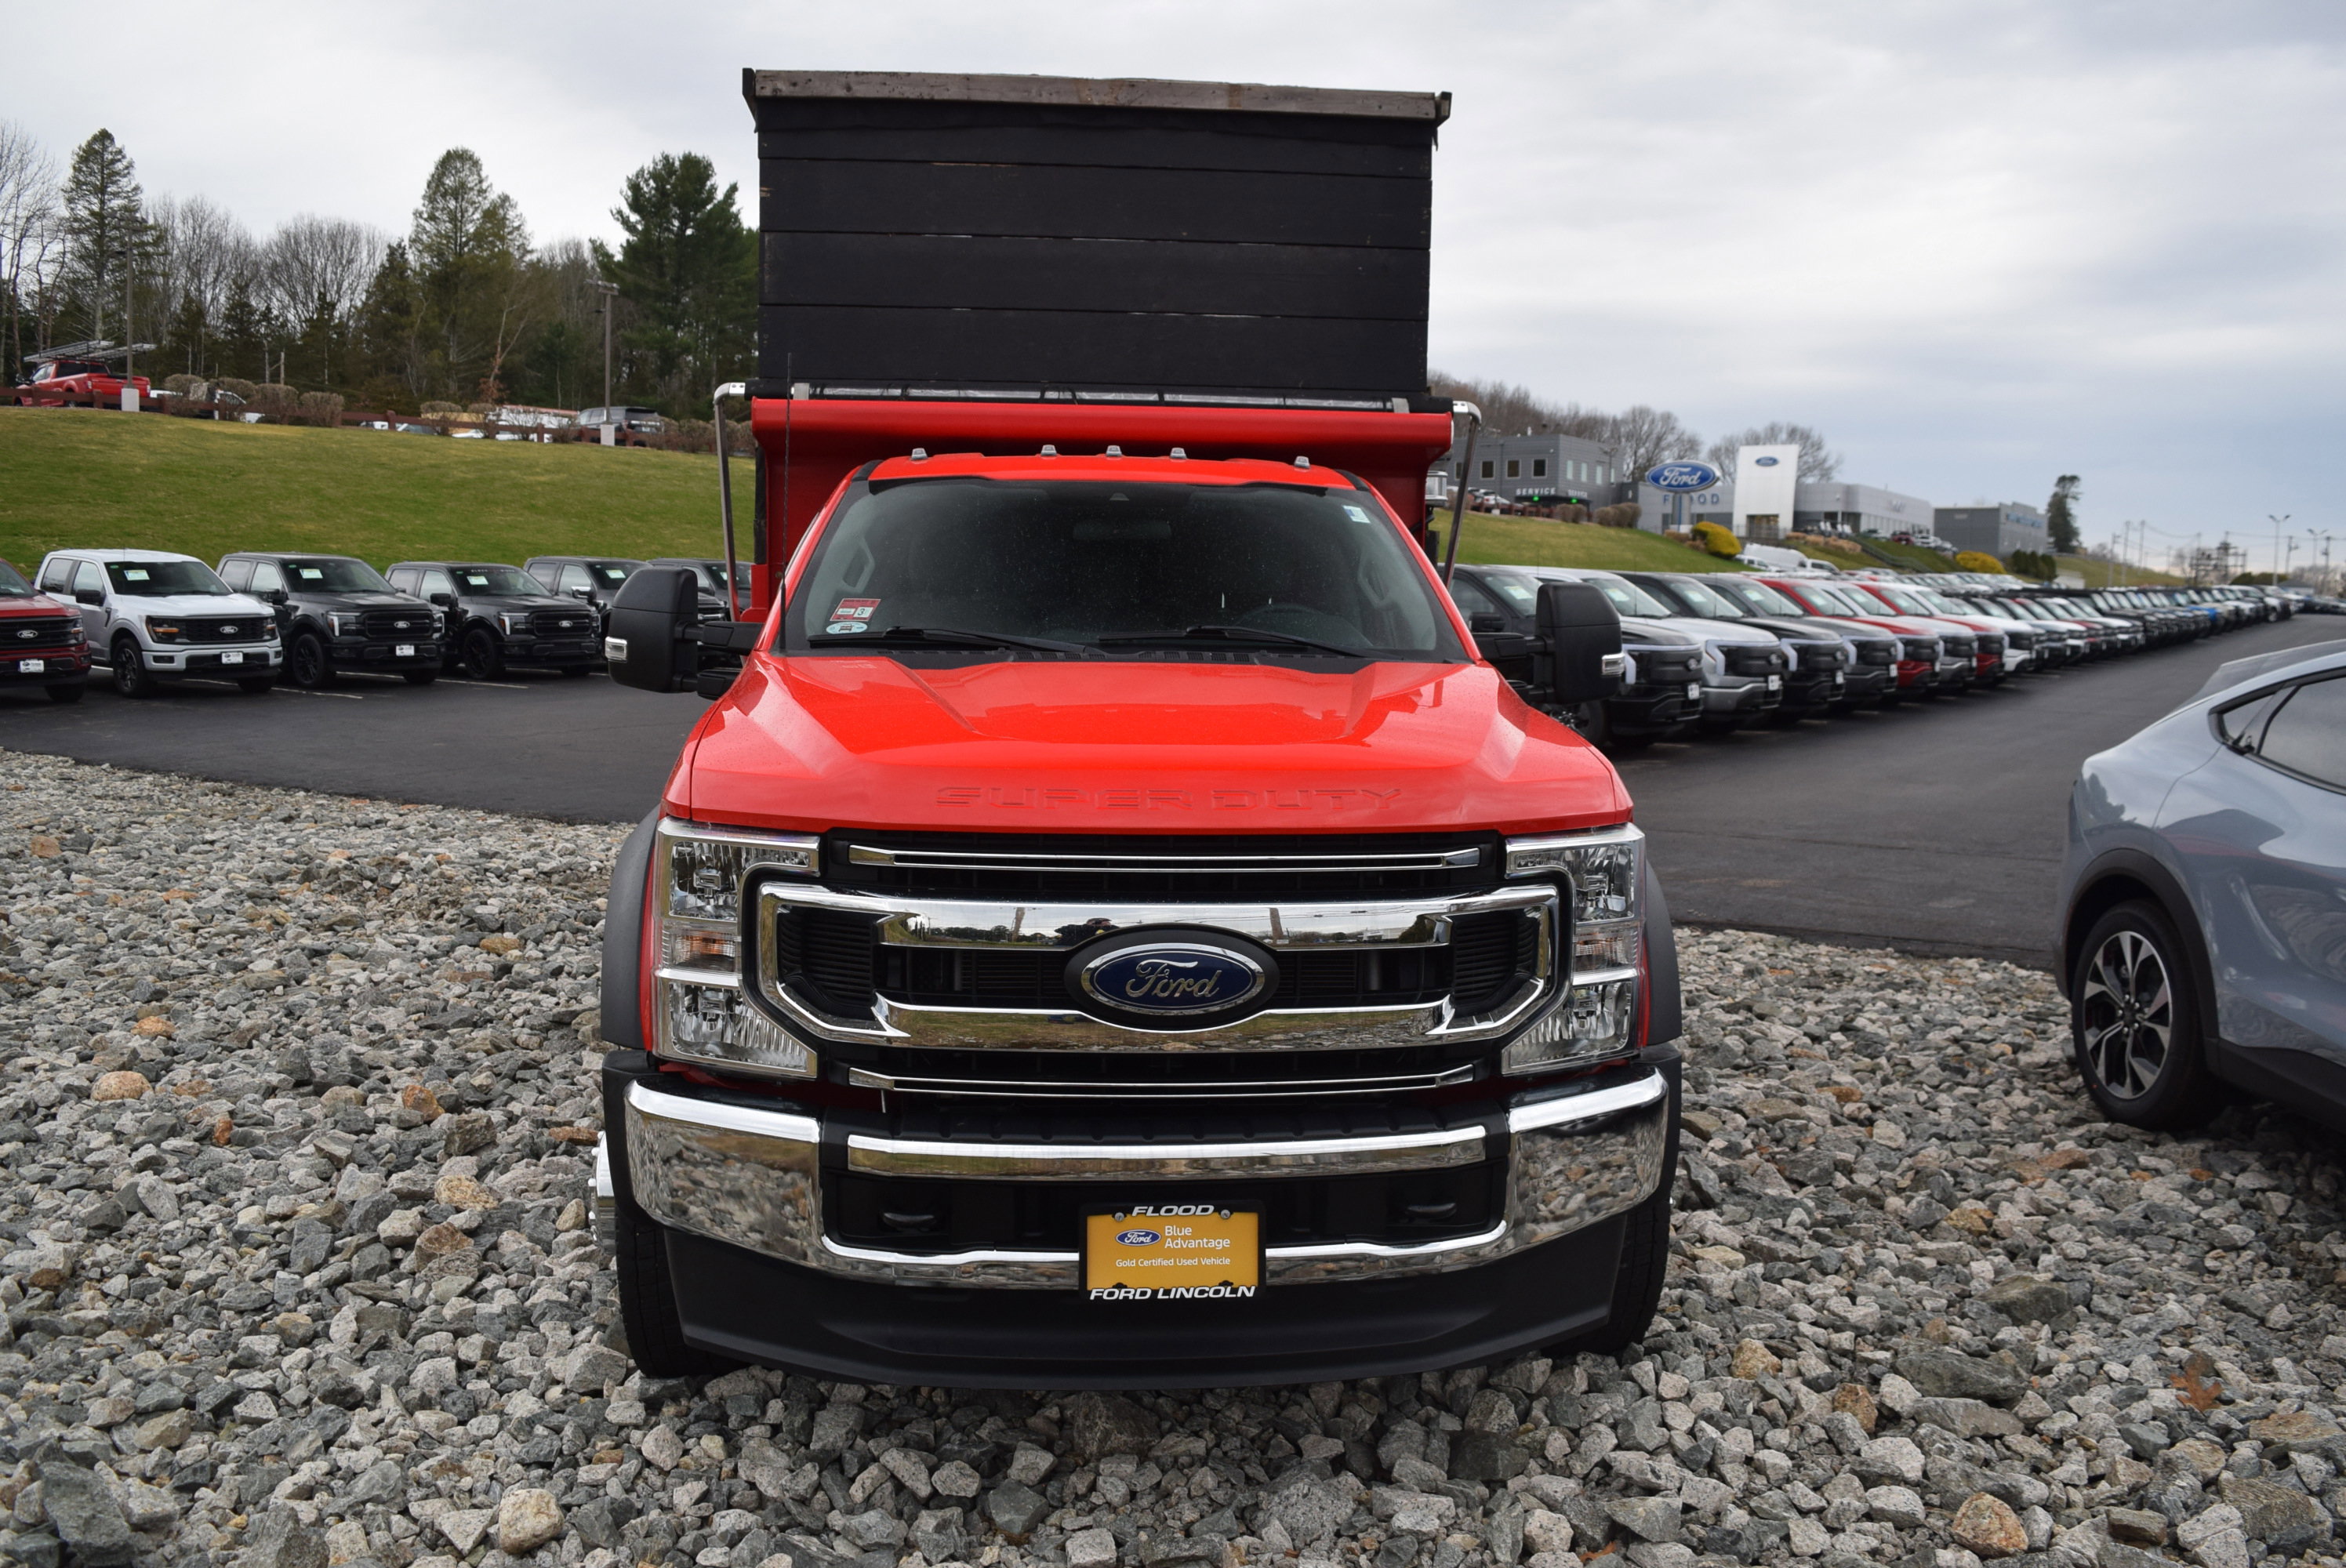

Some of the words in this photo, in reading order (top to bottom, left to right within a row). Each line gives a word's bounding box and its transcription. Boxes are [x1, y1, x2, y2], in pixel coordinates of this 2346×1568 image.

[1659, 466, 1702, 485] Ford
[1516, 487, 1556, 495] SERVICE
[1663, 493, 1720, 505] FOD
[935, 786, 1193, 810] SUPER
[1211, 789, 1401, 810] DUTY
[1125, 959, 1222, 998] Ford
[1131, 1205, 1215, 1217] FLOOD
[1164, 1225, 1192, 1236] Blue
[1124, 1232, 1152, 1243] Ford
[1164, 1238, 1230, 1250] Advantage
[1116, 1258, 1136, 1267] Gold
[1138, 1258, 1174, 1267] Certified
[1176, 1258, 1198, 1266] Used
[1200, 1256, 1230, 1265] Vehicle
[1090, 1288, 1152, 1300] FORD
[1157, 1286, 1255, 1299] LINCOLN
